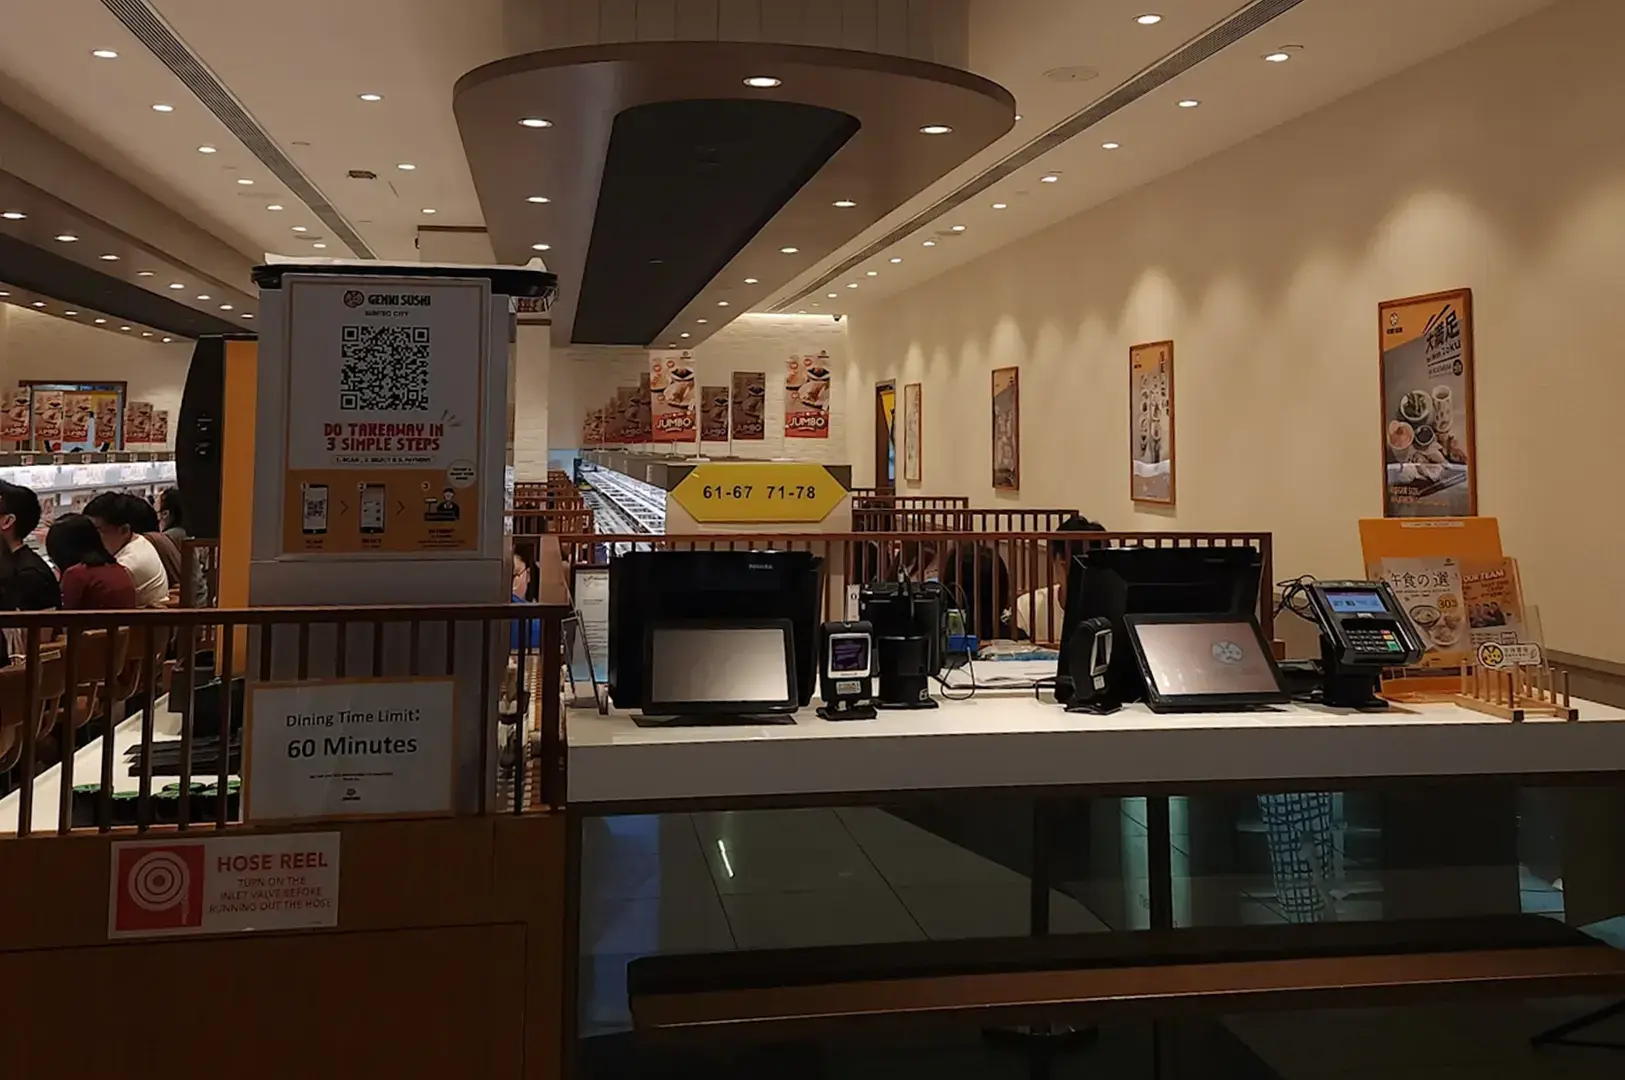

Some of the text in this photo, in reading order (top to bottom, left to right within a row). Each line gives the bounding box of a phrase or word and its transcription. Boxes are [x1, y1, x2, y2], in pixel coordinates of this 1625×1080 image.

[368, 294, 431, 306] GENKI SUSHI
[656, 417, 692, 429] JUMBO
[789, 416, 825, 427] JUMBO
[324, 423, 444, 437] DO TAKEAWAY IN
[326, 437, 440, 451] 3 SIMPLE STEPS
[703, 485, 816, 500] 61-67 71-78
[1438, 599, 1452, 609] 30
[286, 707, 420, 729] Dining Time Limit:
[287, 736, 418, 759] 60 Minutes
[218, 852, 328, 873] HOSE REEL
[238, 875, 307, 888] TURN ON THE
[284, 886, 322, 898] BEFORE
[260, 900, 282, 912] OUT
[284, 899, 303, 910] THE
[305, 898, 332, 909] HOSE
